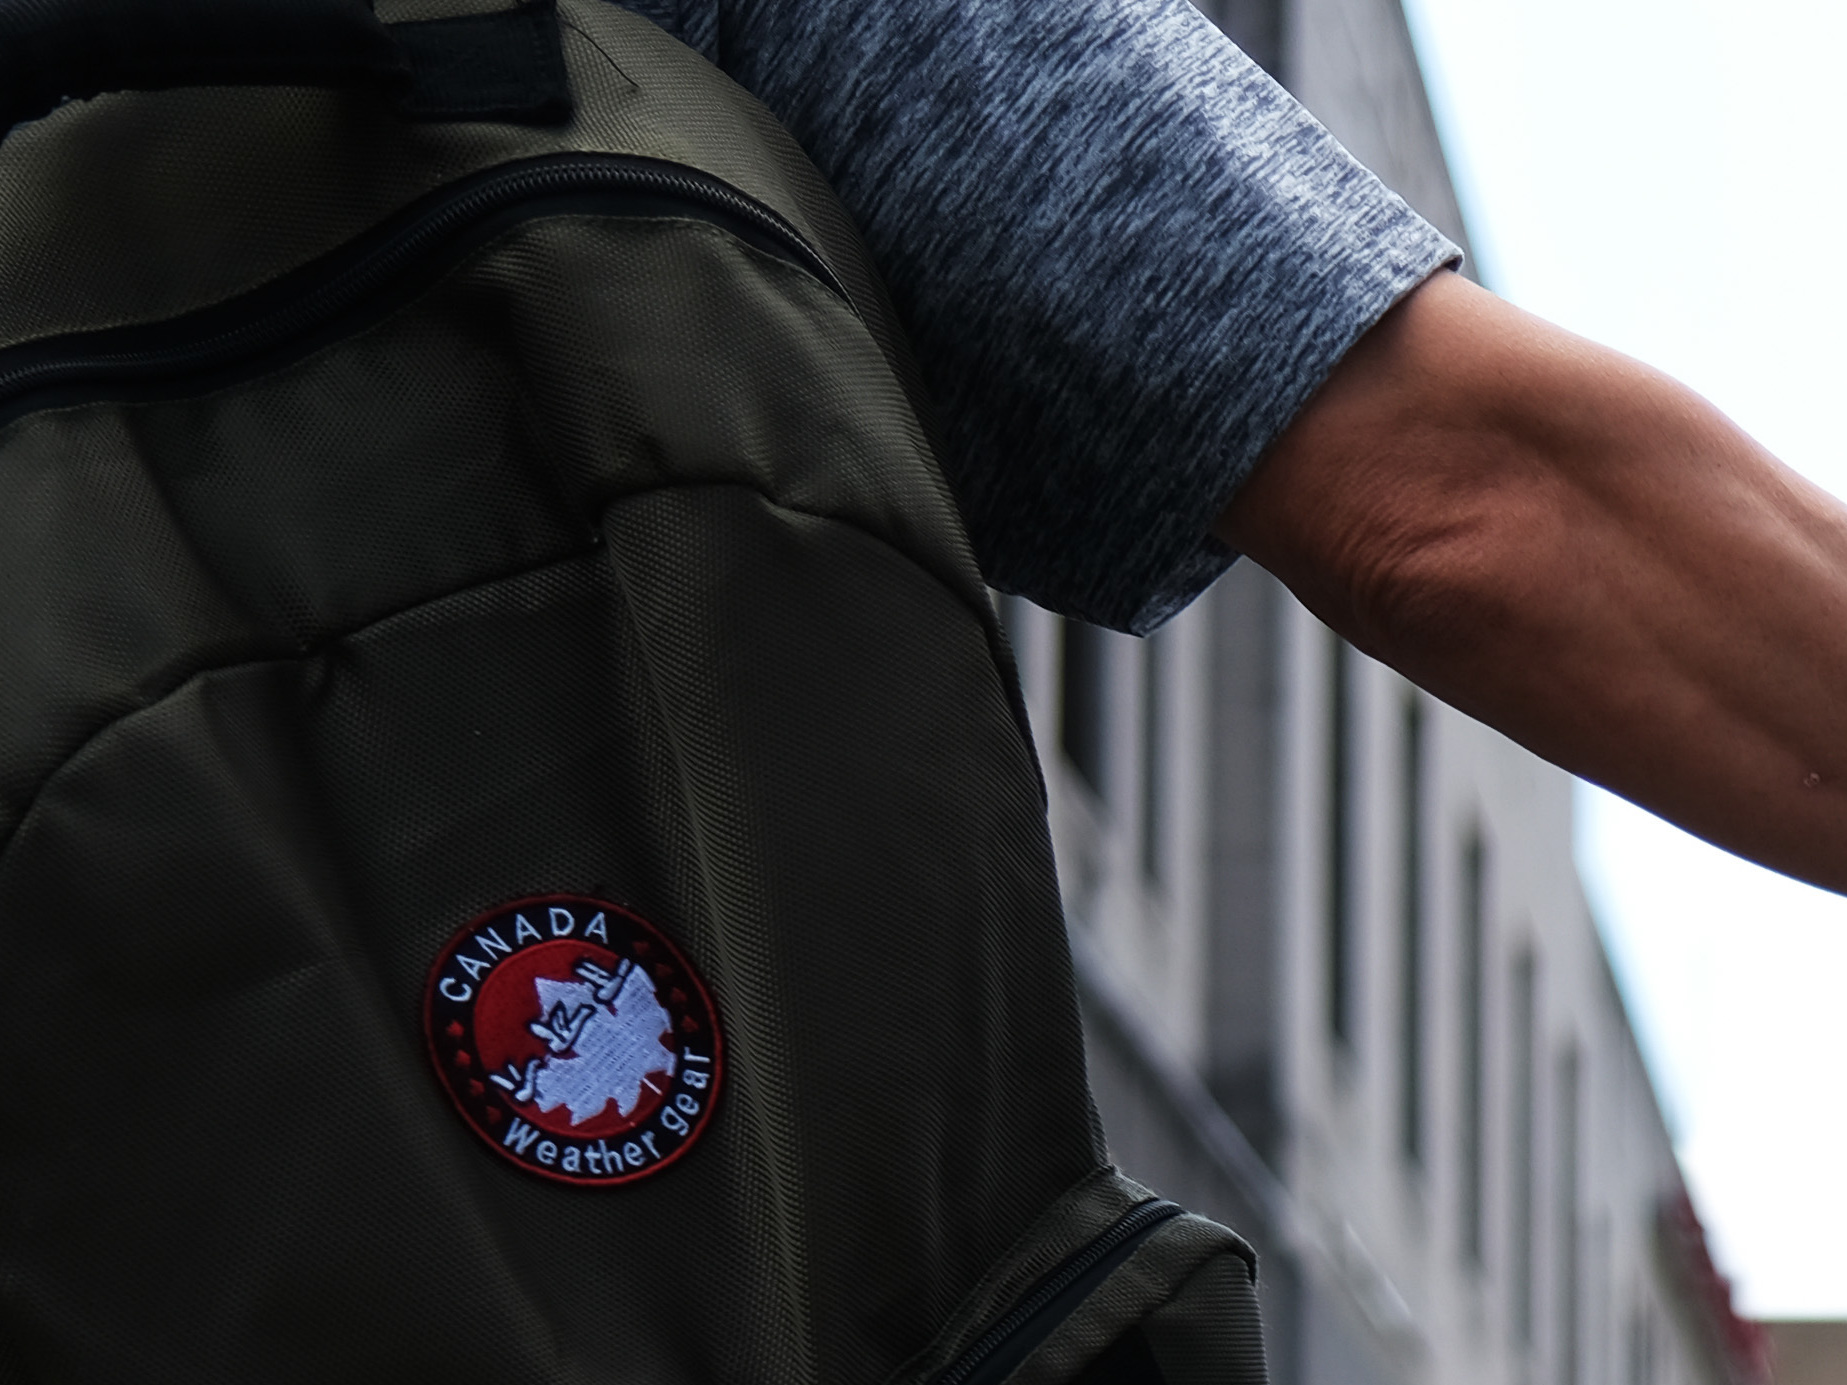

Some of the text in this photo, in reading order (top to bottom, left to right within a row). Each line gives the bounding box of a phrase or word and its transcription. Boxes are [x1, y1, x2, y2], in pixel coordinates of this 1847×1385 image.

[438, 907, 610, 1004] CANADA
[502, 1045, 711, 1175] Weather gear
